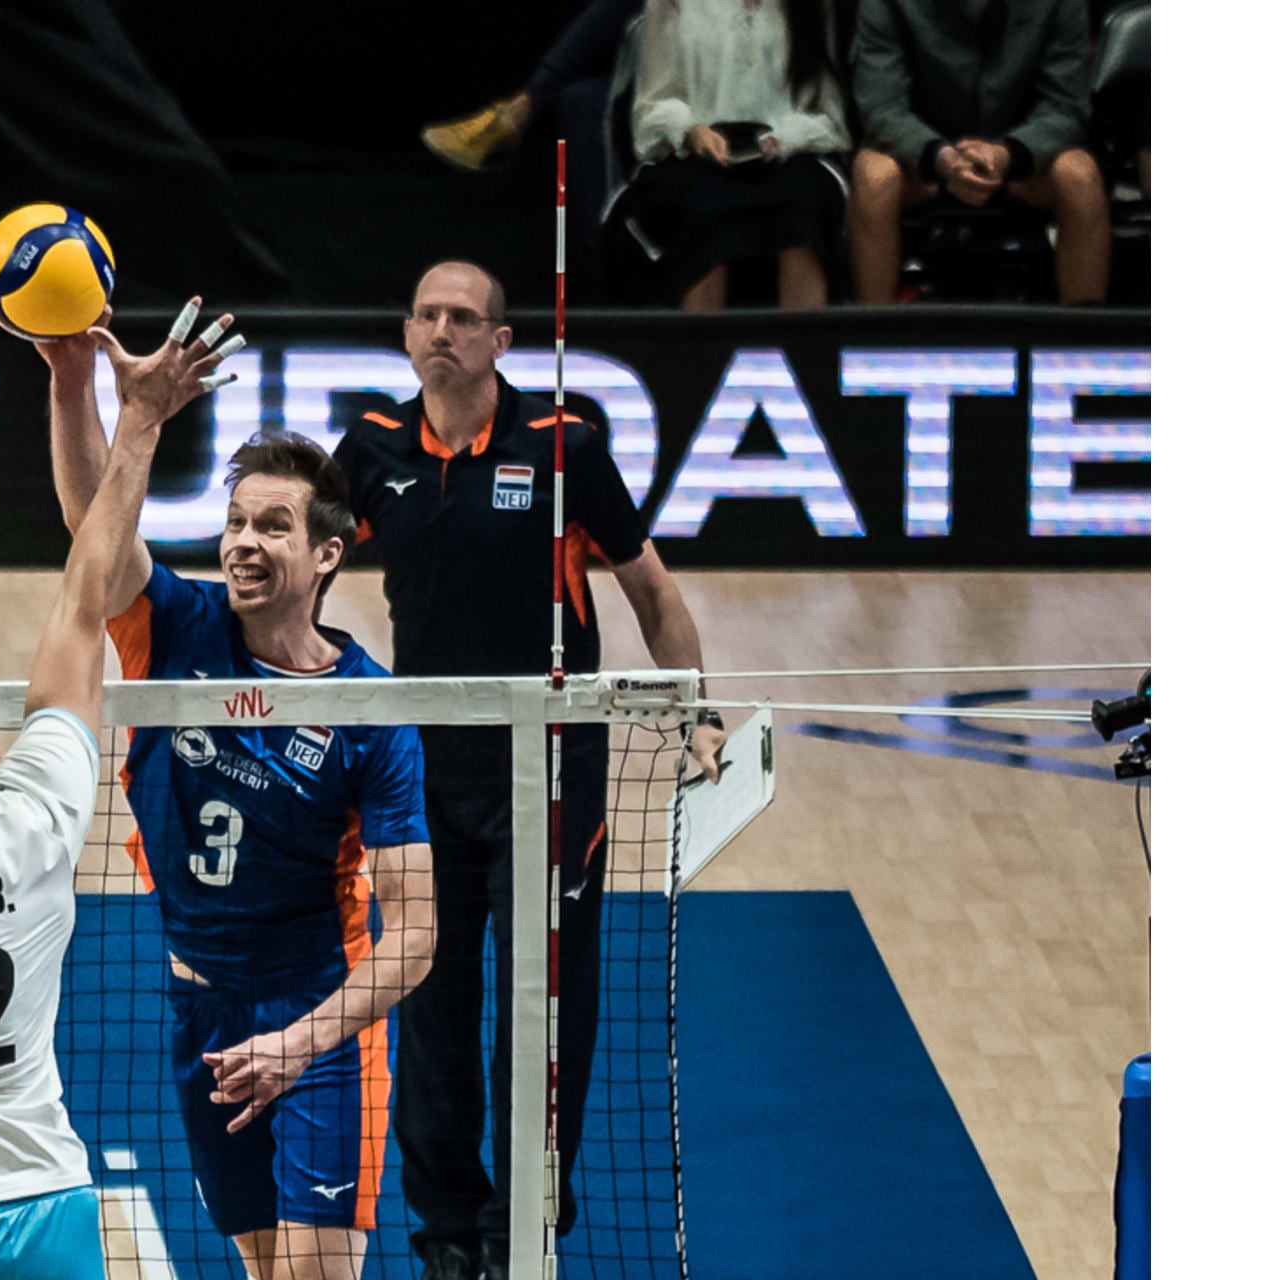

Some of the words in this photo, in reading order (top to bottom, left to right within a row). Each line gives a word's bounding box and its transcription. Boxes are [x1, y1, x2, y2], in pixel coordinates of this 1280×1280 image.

[494, 491, 530, 508] NED
[224, 686, 274, 718] VNL
[290, 736, 323, 770] NED
[189, 800, 244, 887] 3
